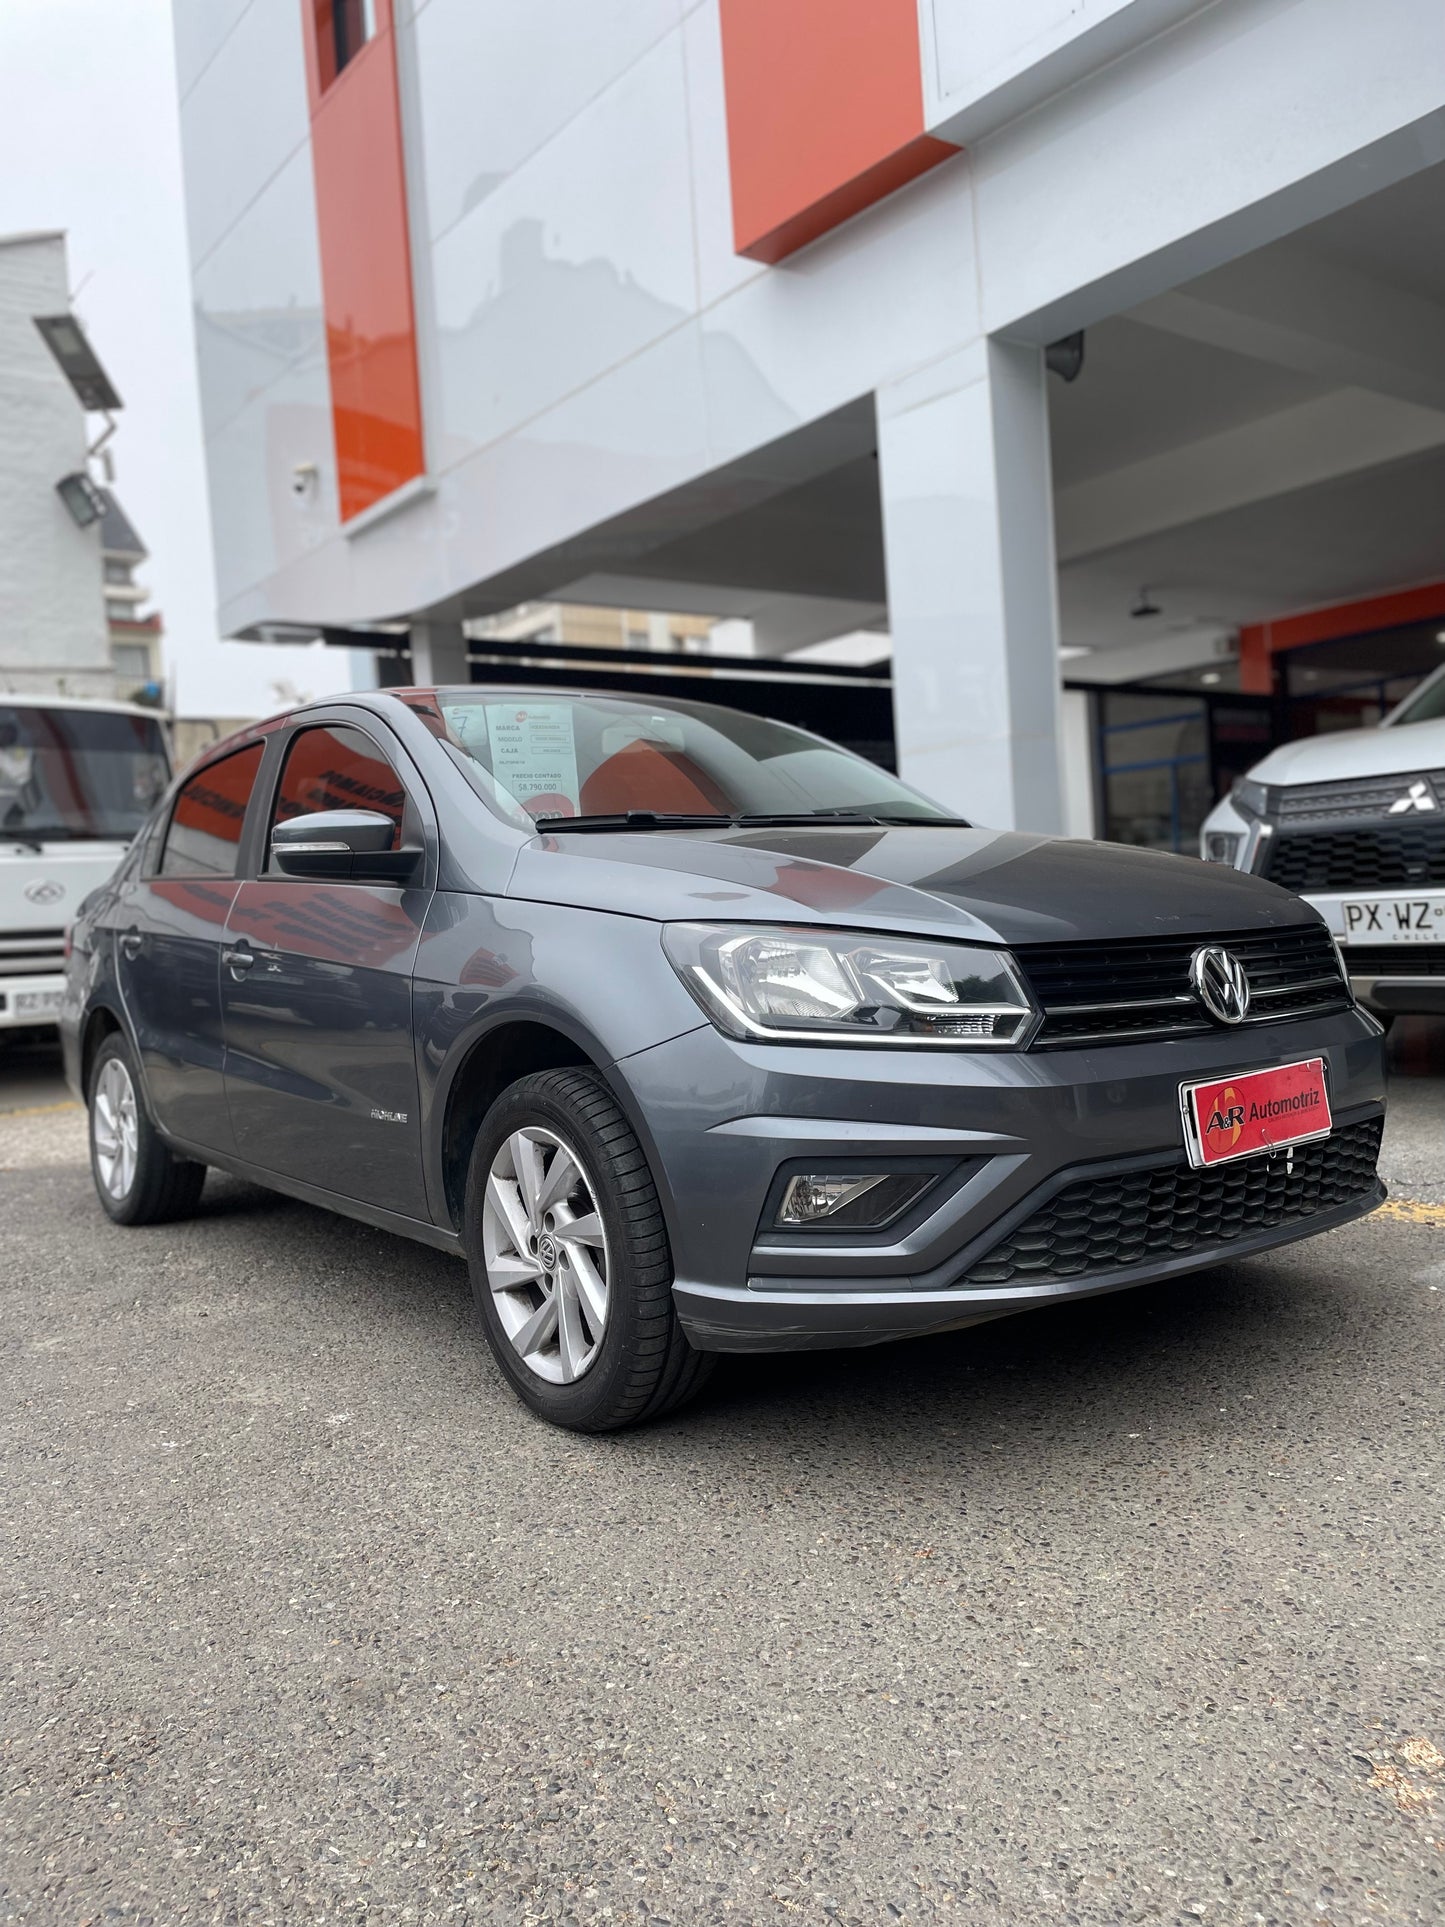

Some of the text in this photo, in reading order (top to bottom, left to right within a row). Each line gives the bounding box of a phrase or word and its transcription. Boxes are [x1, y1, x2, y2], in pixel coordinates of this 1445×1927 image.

[518, 783, 557, 792] $8.790.000
[1392, 933, 1441, 941] CHILE
[370, 1108, 408, 1124] HIGHLINE
[1206, 1105, 1246, 1134] A&R
[1249, 1087, 1320, 1123] Automotriz
